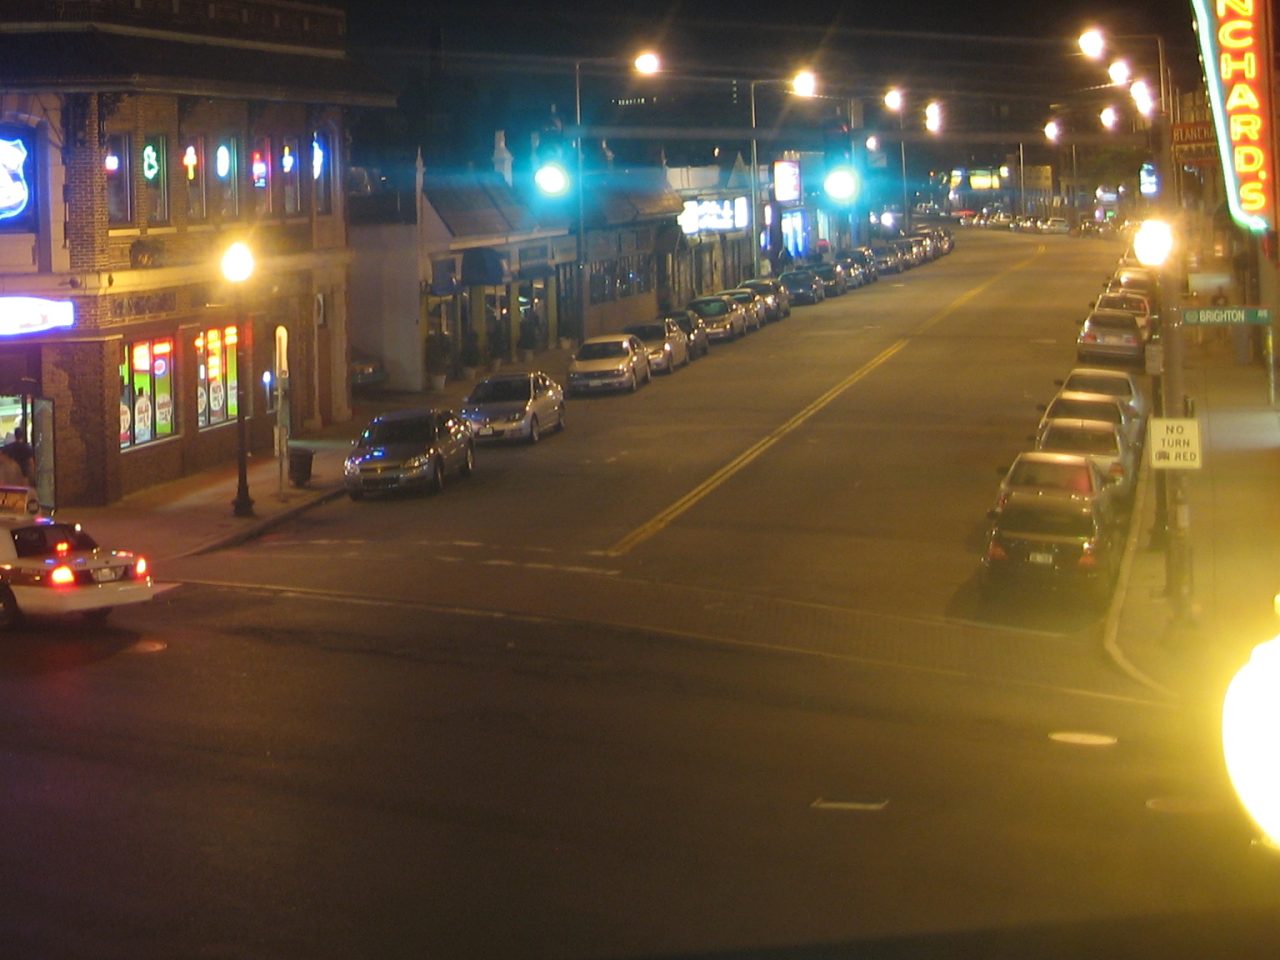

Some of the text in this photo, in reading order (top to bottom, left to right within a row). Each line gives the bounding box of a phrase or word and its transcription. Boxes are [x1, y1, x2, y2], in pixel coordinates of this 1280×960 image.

[1173, 126, 1214, 141] BLANCHA
[1200, 310, 1245, 322] BRIGHTON
[1166, 425, 1184, 435] NO
[1161, 439, 1190, 448] TURN
[1175, 452, 1197, 461] RED
